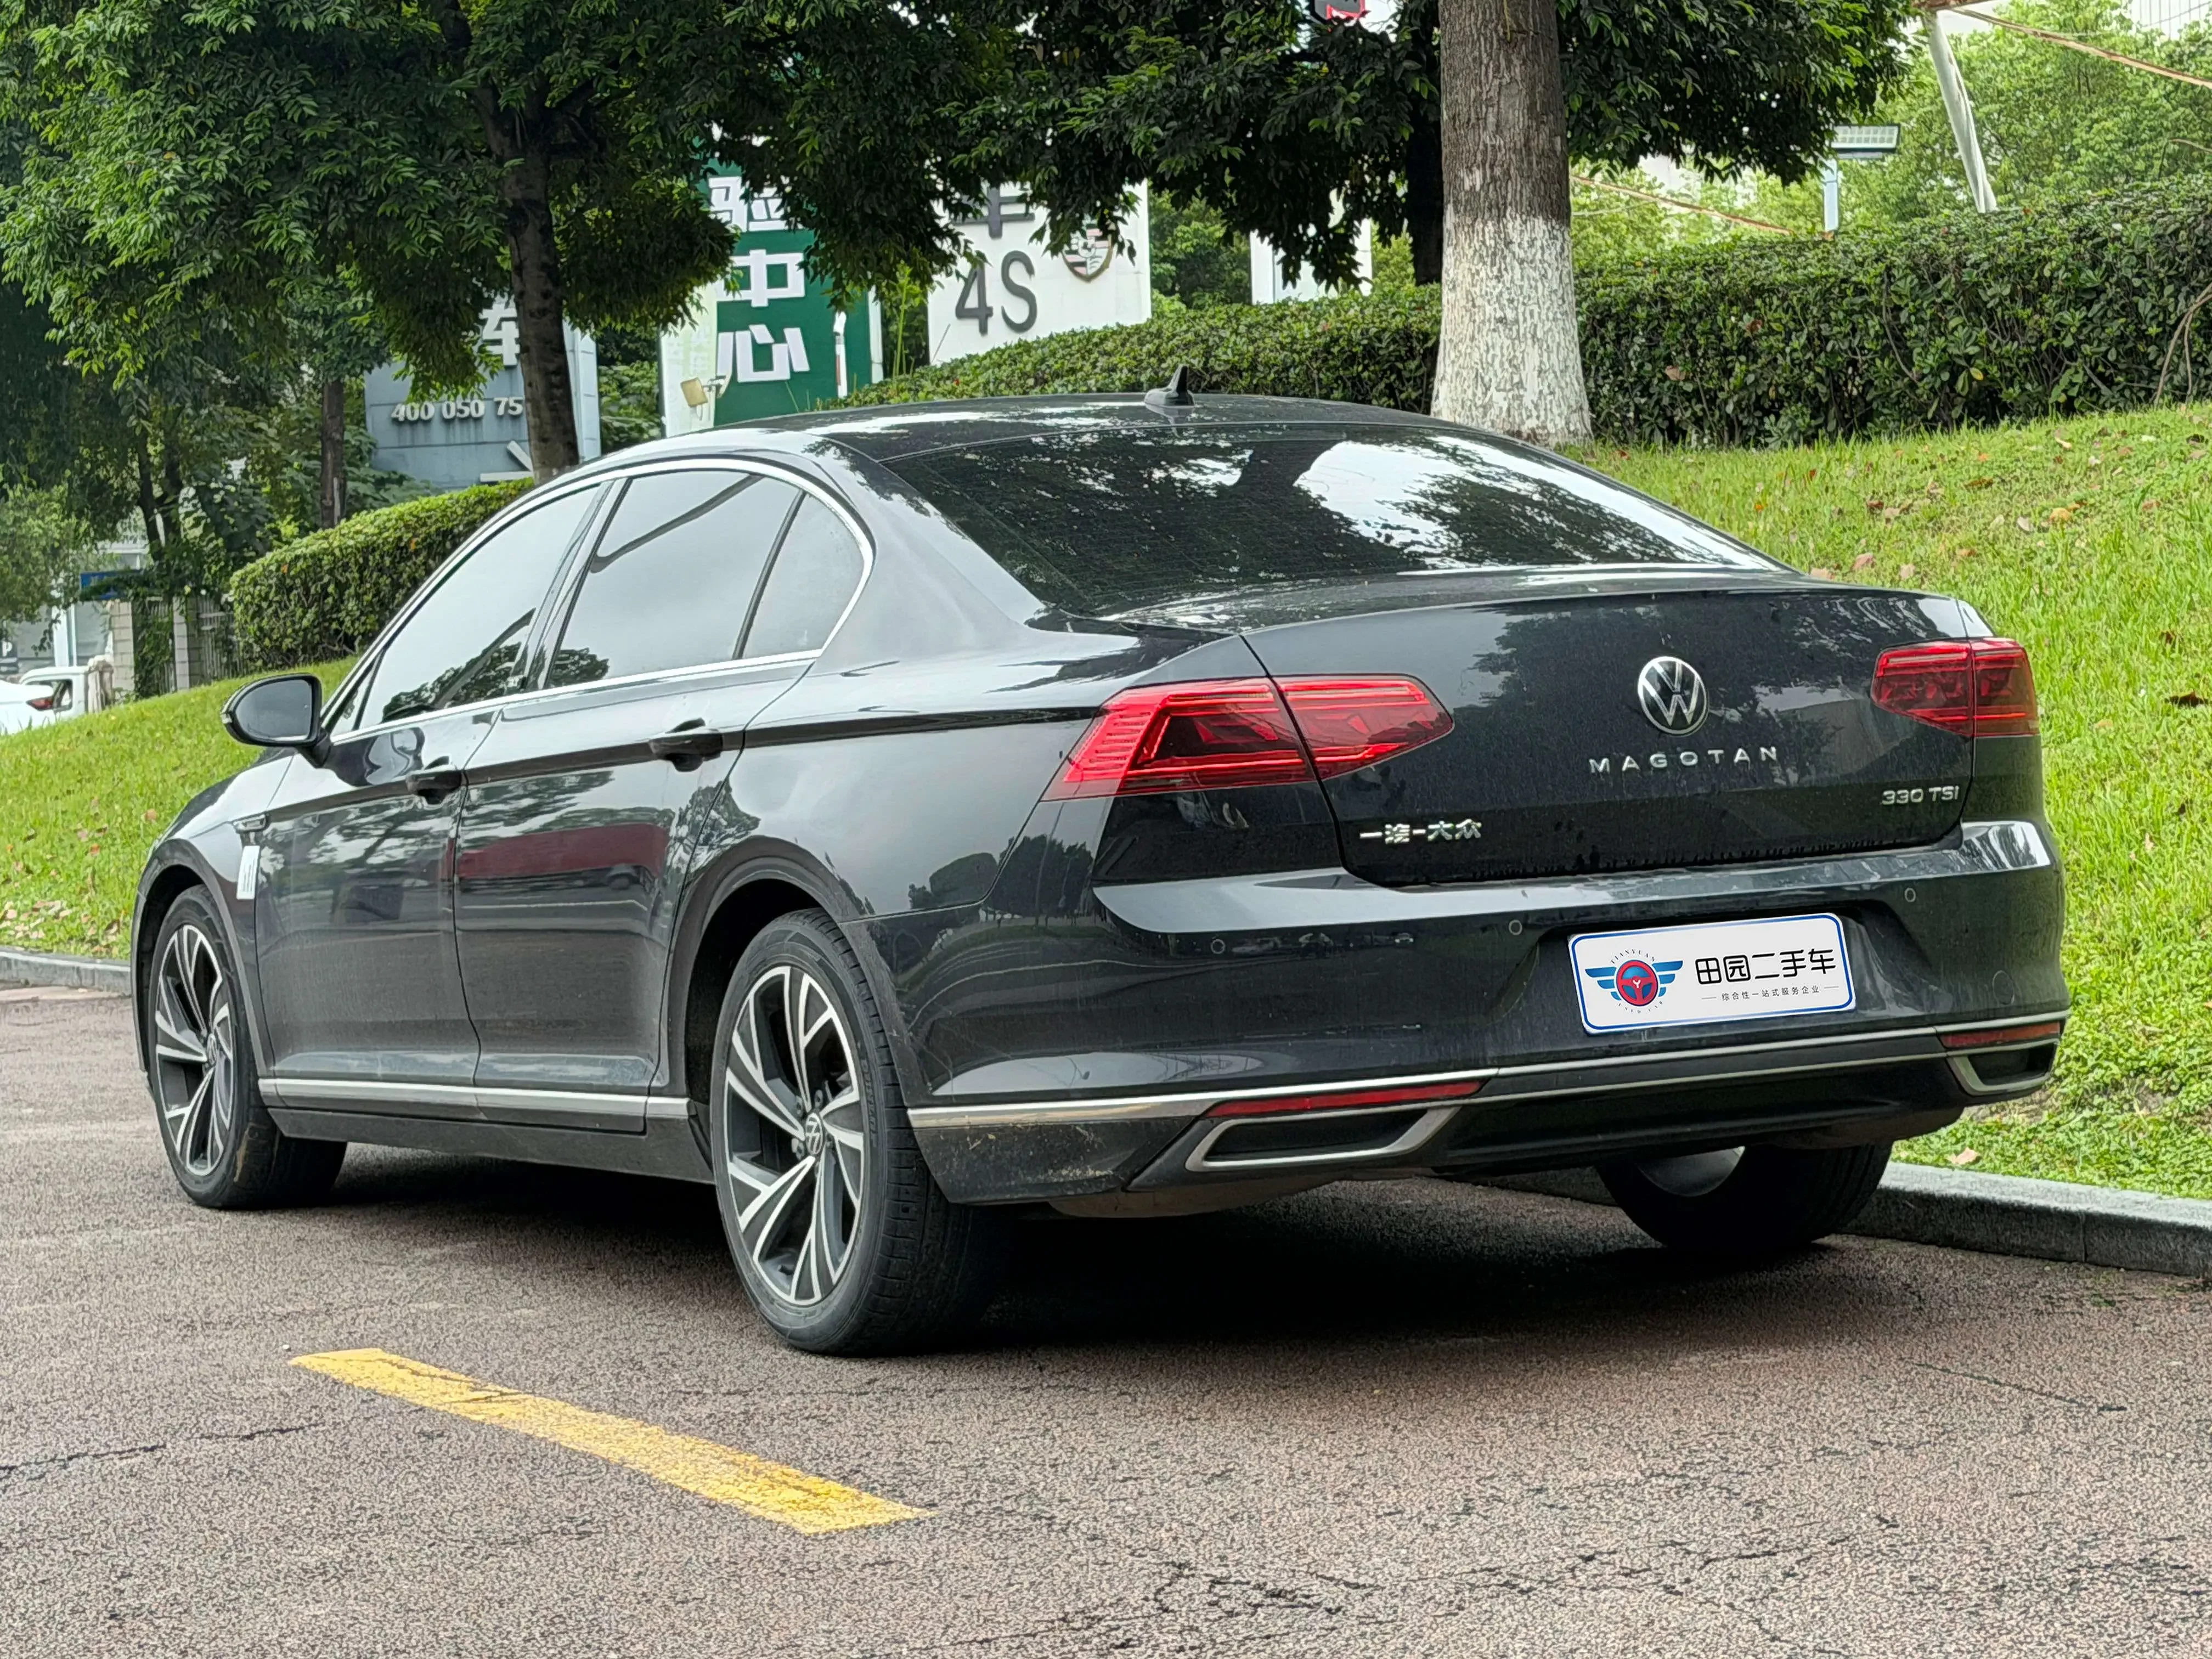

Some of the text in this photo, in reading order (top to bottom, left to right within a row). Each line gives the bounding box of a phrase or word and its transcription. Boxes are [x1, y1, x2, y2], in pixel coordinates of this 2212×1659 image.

[955, 250, 1037, 337] 4S
[391, 401, 435, 422] 400
[442, 399, 485, 419] 050
[1589, 746, 1777, 774] MAGOTAN
[1882, 786, 1959, 805] 330 TSI
